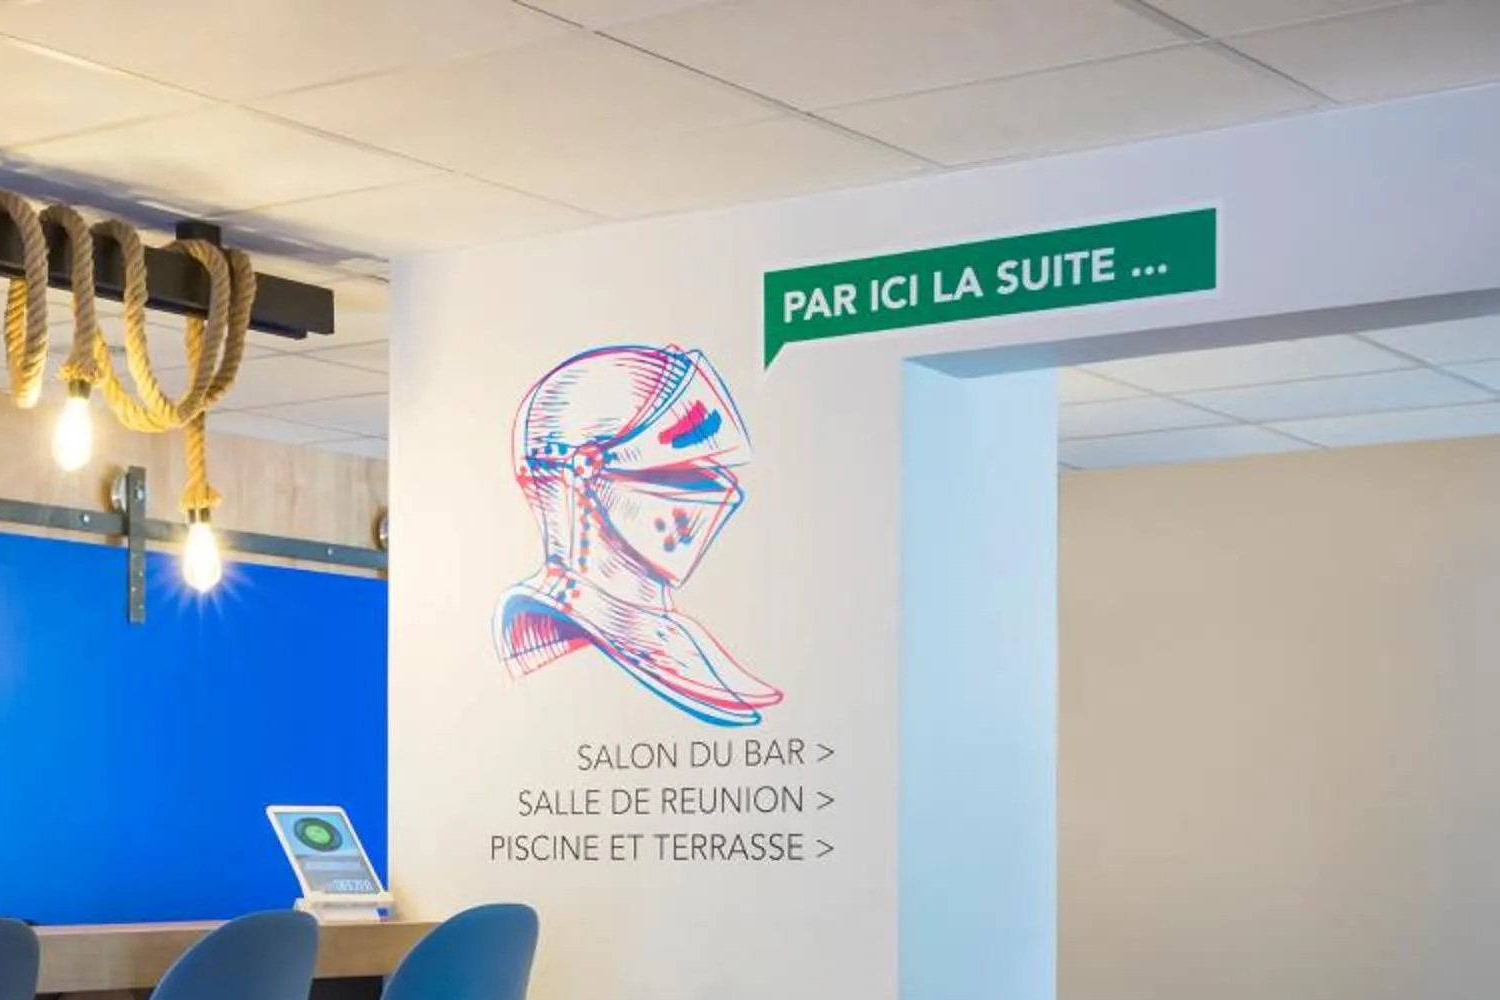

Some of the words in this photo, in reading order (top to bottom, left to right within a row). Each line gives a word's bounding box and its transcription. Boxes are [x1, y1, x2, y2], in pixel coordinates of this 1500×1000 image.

[783, 284, 857, 323] PAR
[871, 274, 918, 311] ICI
[933, 266, 983, 303] LA
[996, 247, 1115, 295] SUITE
[577, 742, 678, 772] SALON
[690, 740, 733, 768] DU
[745, 737, 806, 767] BAR
[518, 788, 601, 817] SALLE
[611, 787, 651, 815] DE
[661, 785, 803, 815] REUNION
[490, 833, 600, 862] PISCINE
[610, 833, 645, 861] ET
[653, 832, 805, 862] TERRASSE
